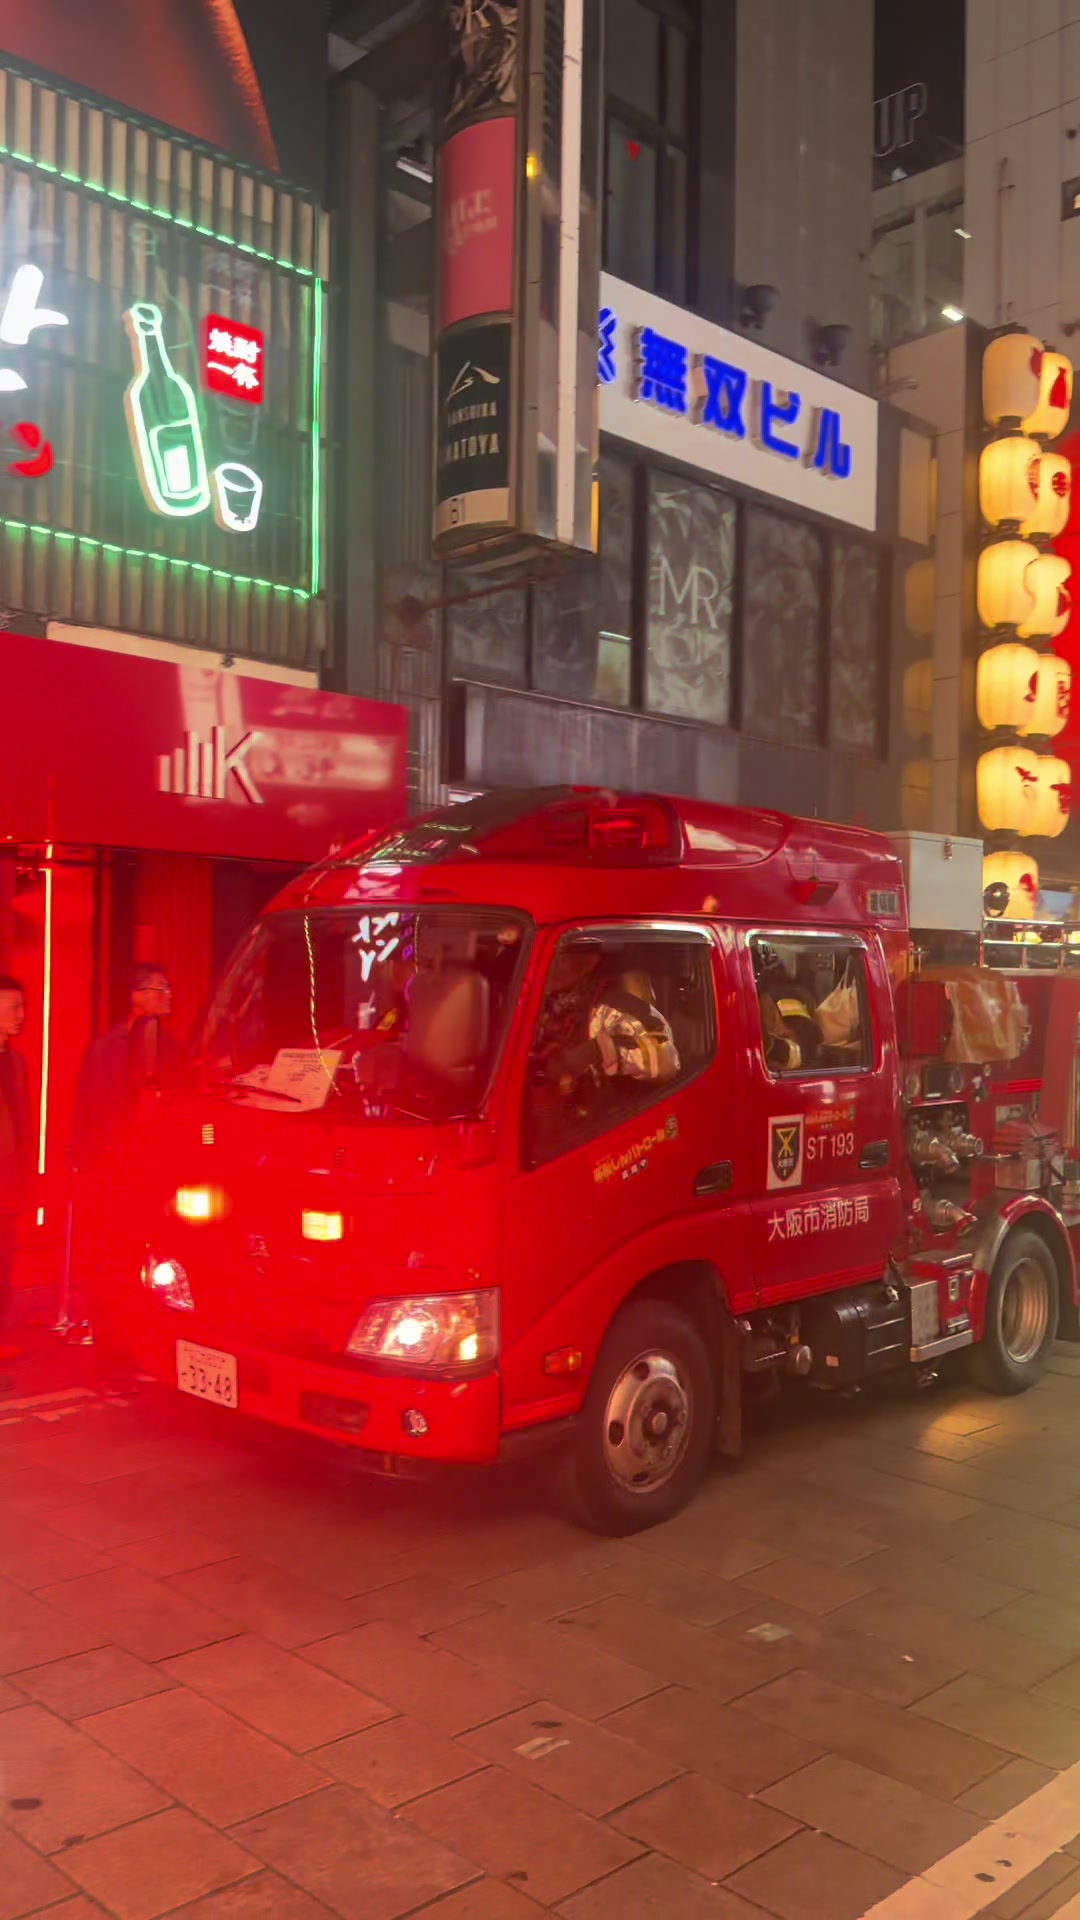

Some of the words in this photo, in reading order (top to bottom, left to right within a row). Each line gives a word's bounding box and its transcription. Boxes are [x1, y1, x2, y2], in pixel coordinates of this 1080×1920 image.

[640, 325, 853, 480] 無双ビル
[806, 1136, 828, 1160] ST
[831, 1131, 855, 1157] 193
[767, 1196, 870, 1242] 大阪市消防局
